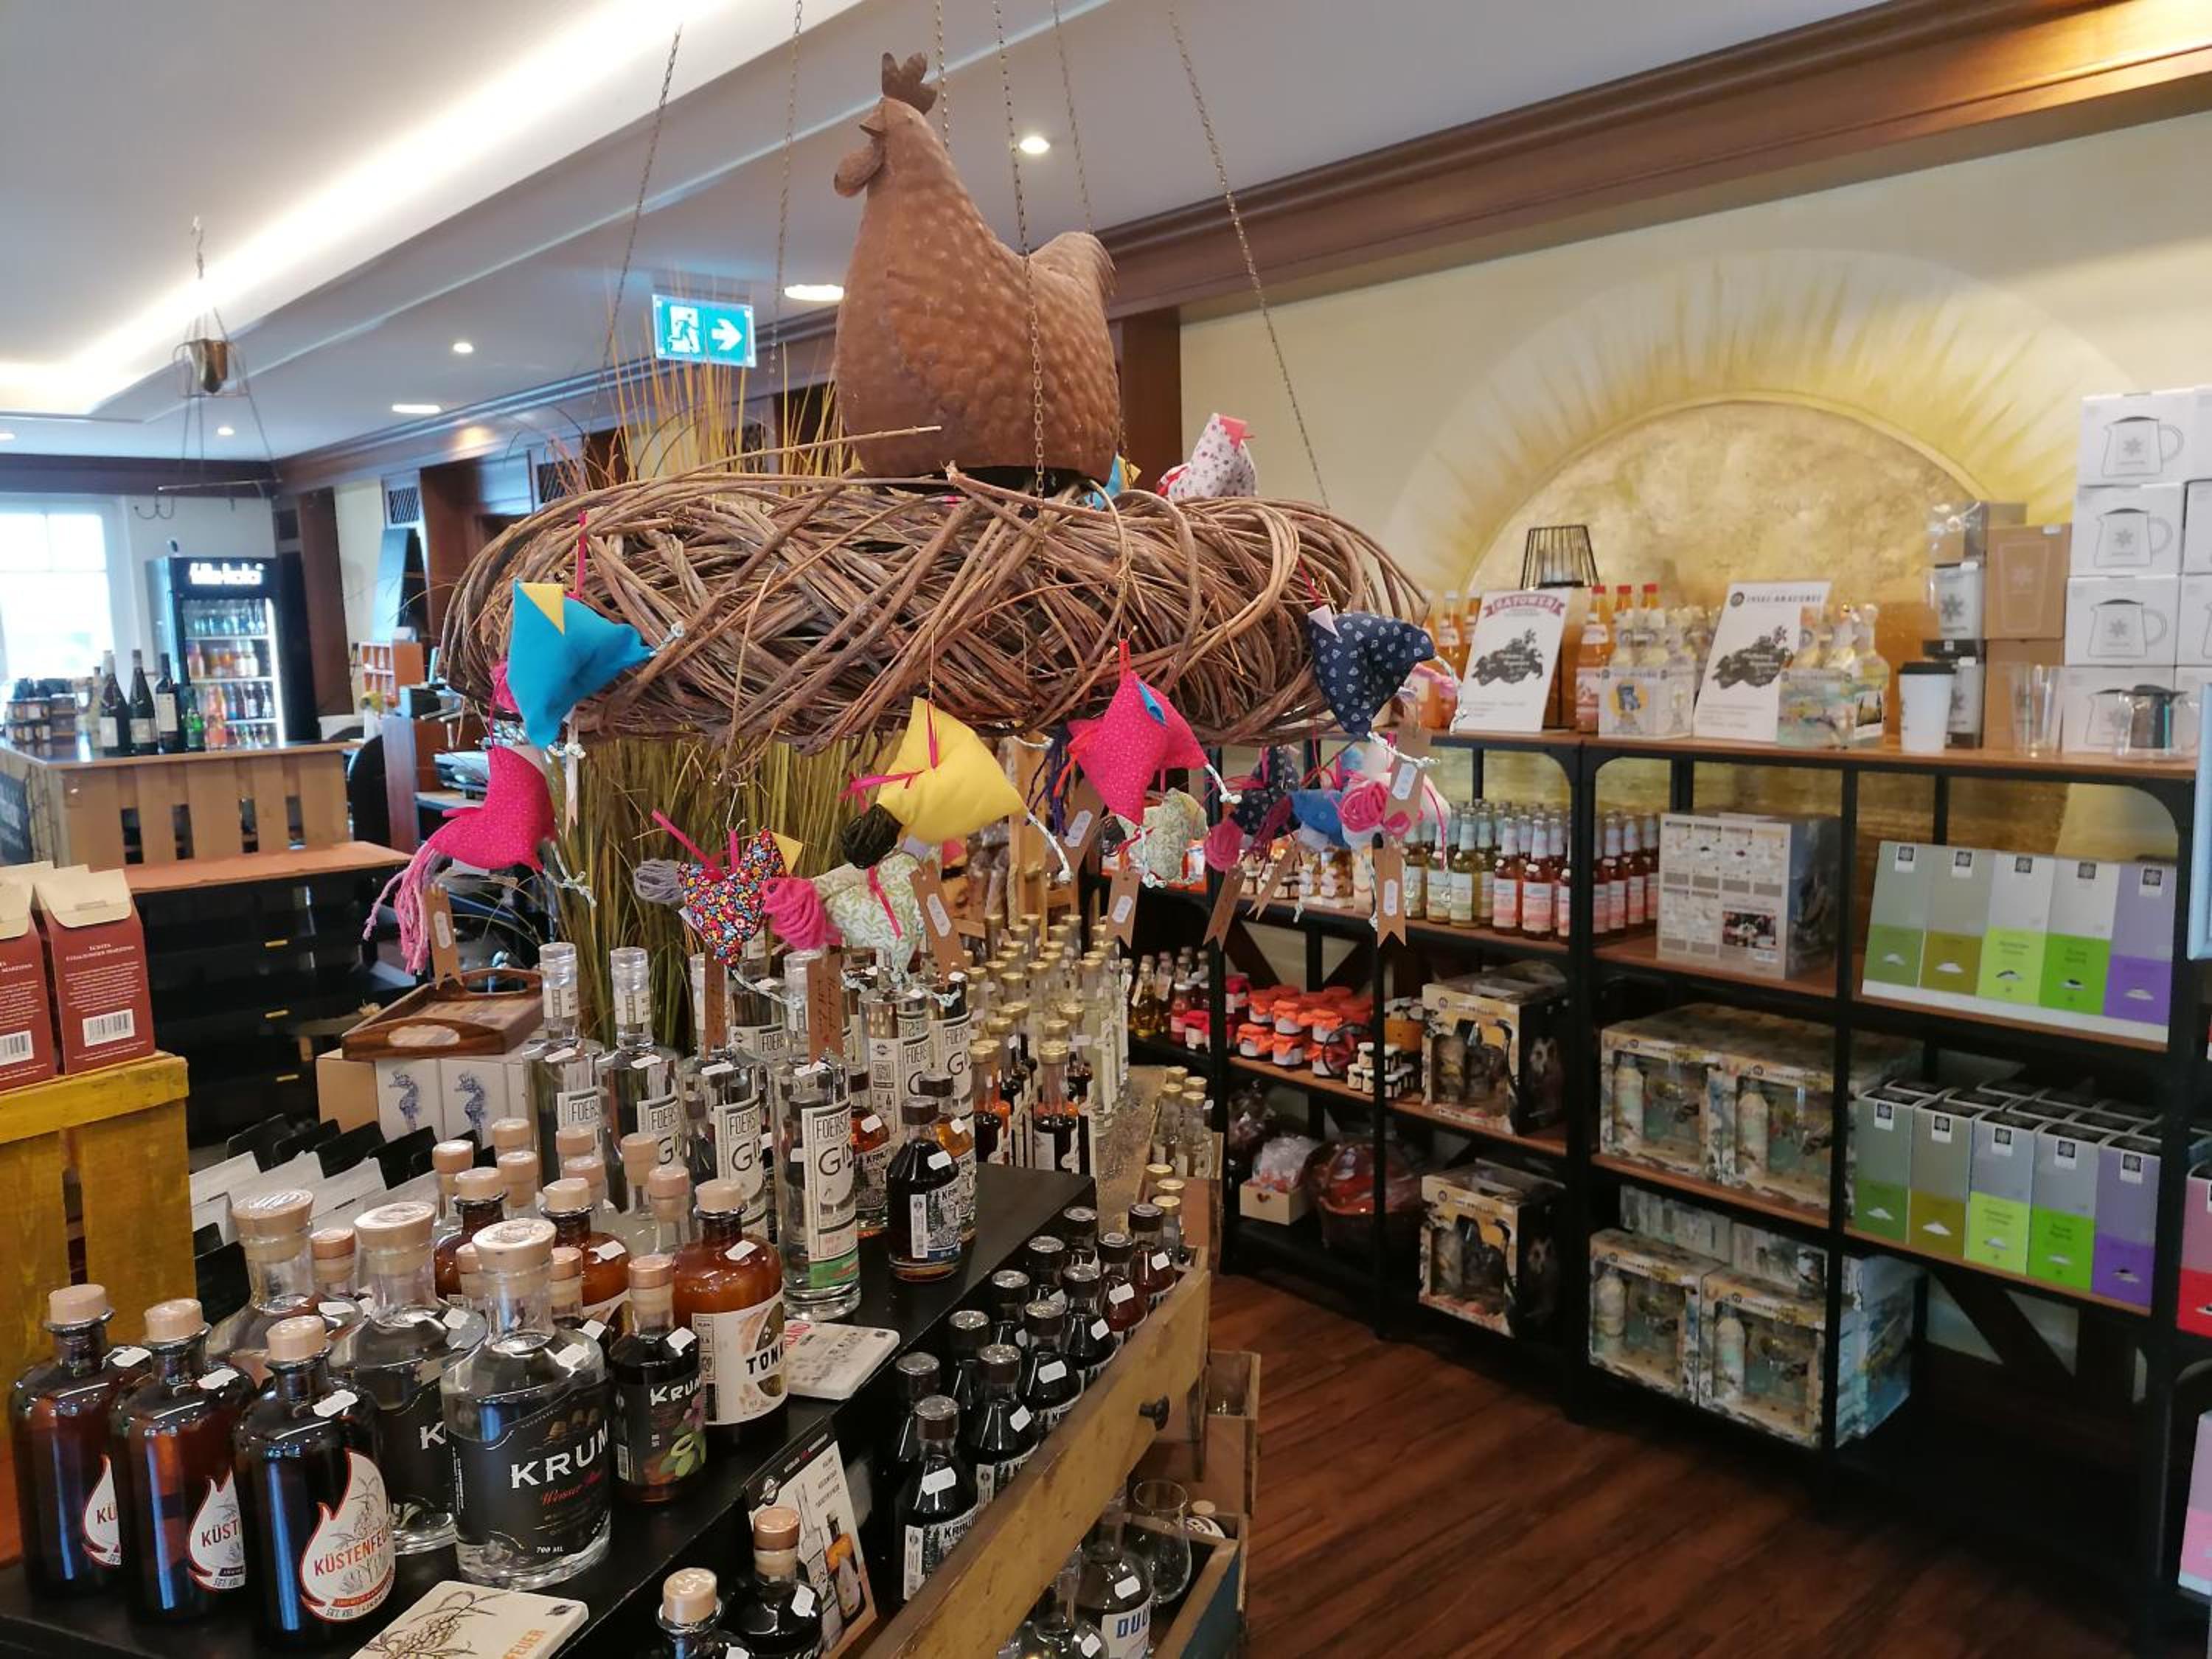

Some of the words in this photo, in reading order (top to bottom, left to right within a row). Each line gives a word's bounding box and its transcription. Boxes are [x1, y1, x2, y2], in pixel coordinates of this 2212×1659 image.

[571, 1097, 598, 1121] FOER
[728, 1111, 757, 1136] FOERS
[419, 1421, 447, 1450] K
[201, 1519, 241, 1548] KÜST
[313, 1519, 392, 1576] KÜSTENFEU
